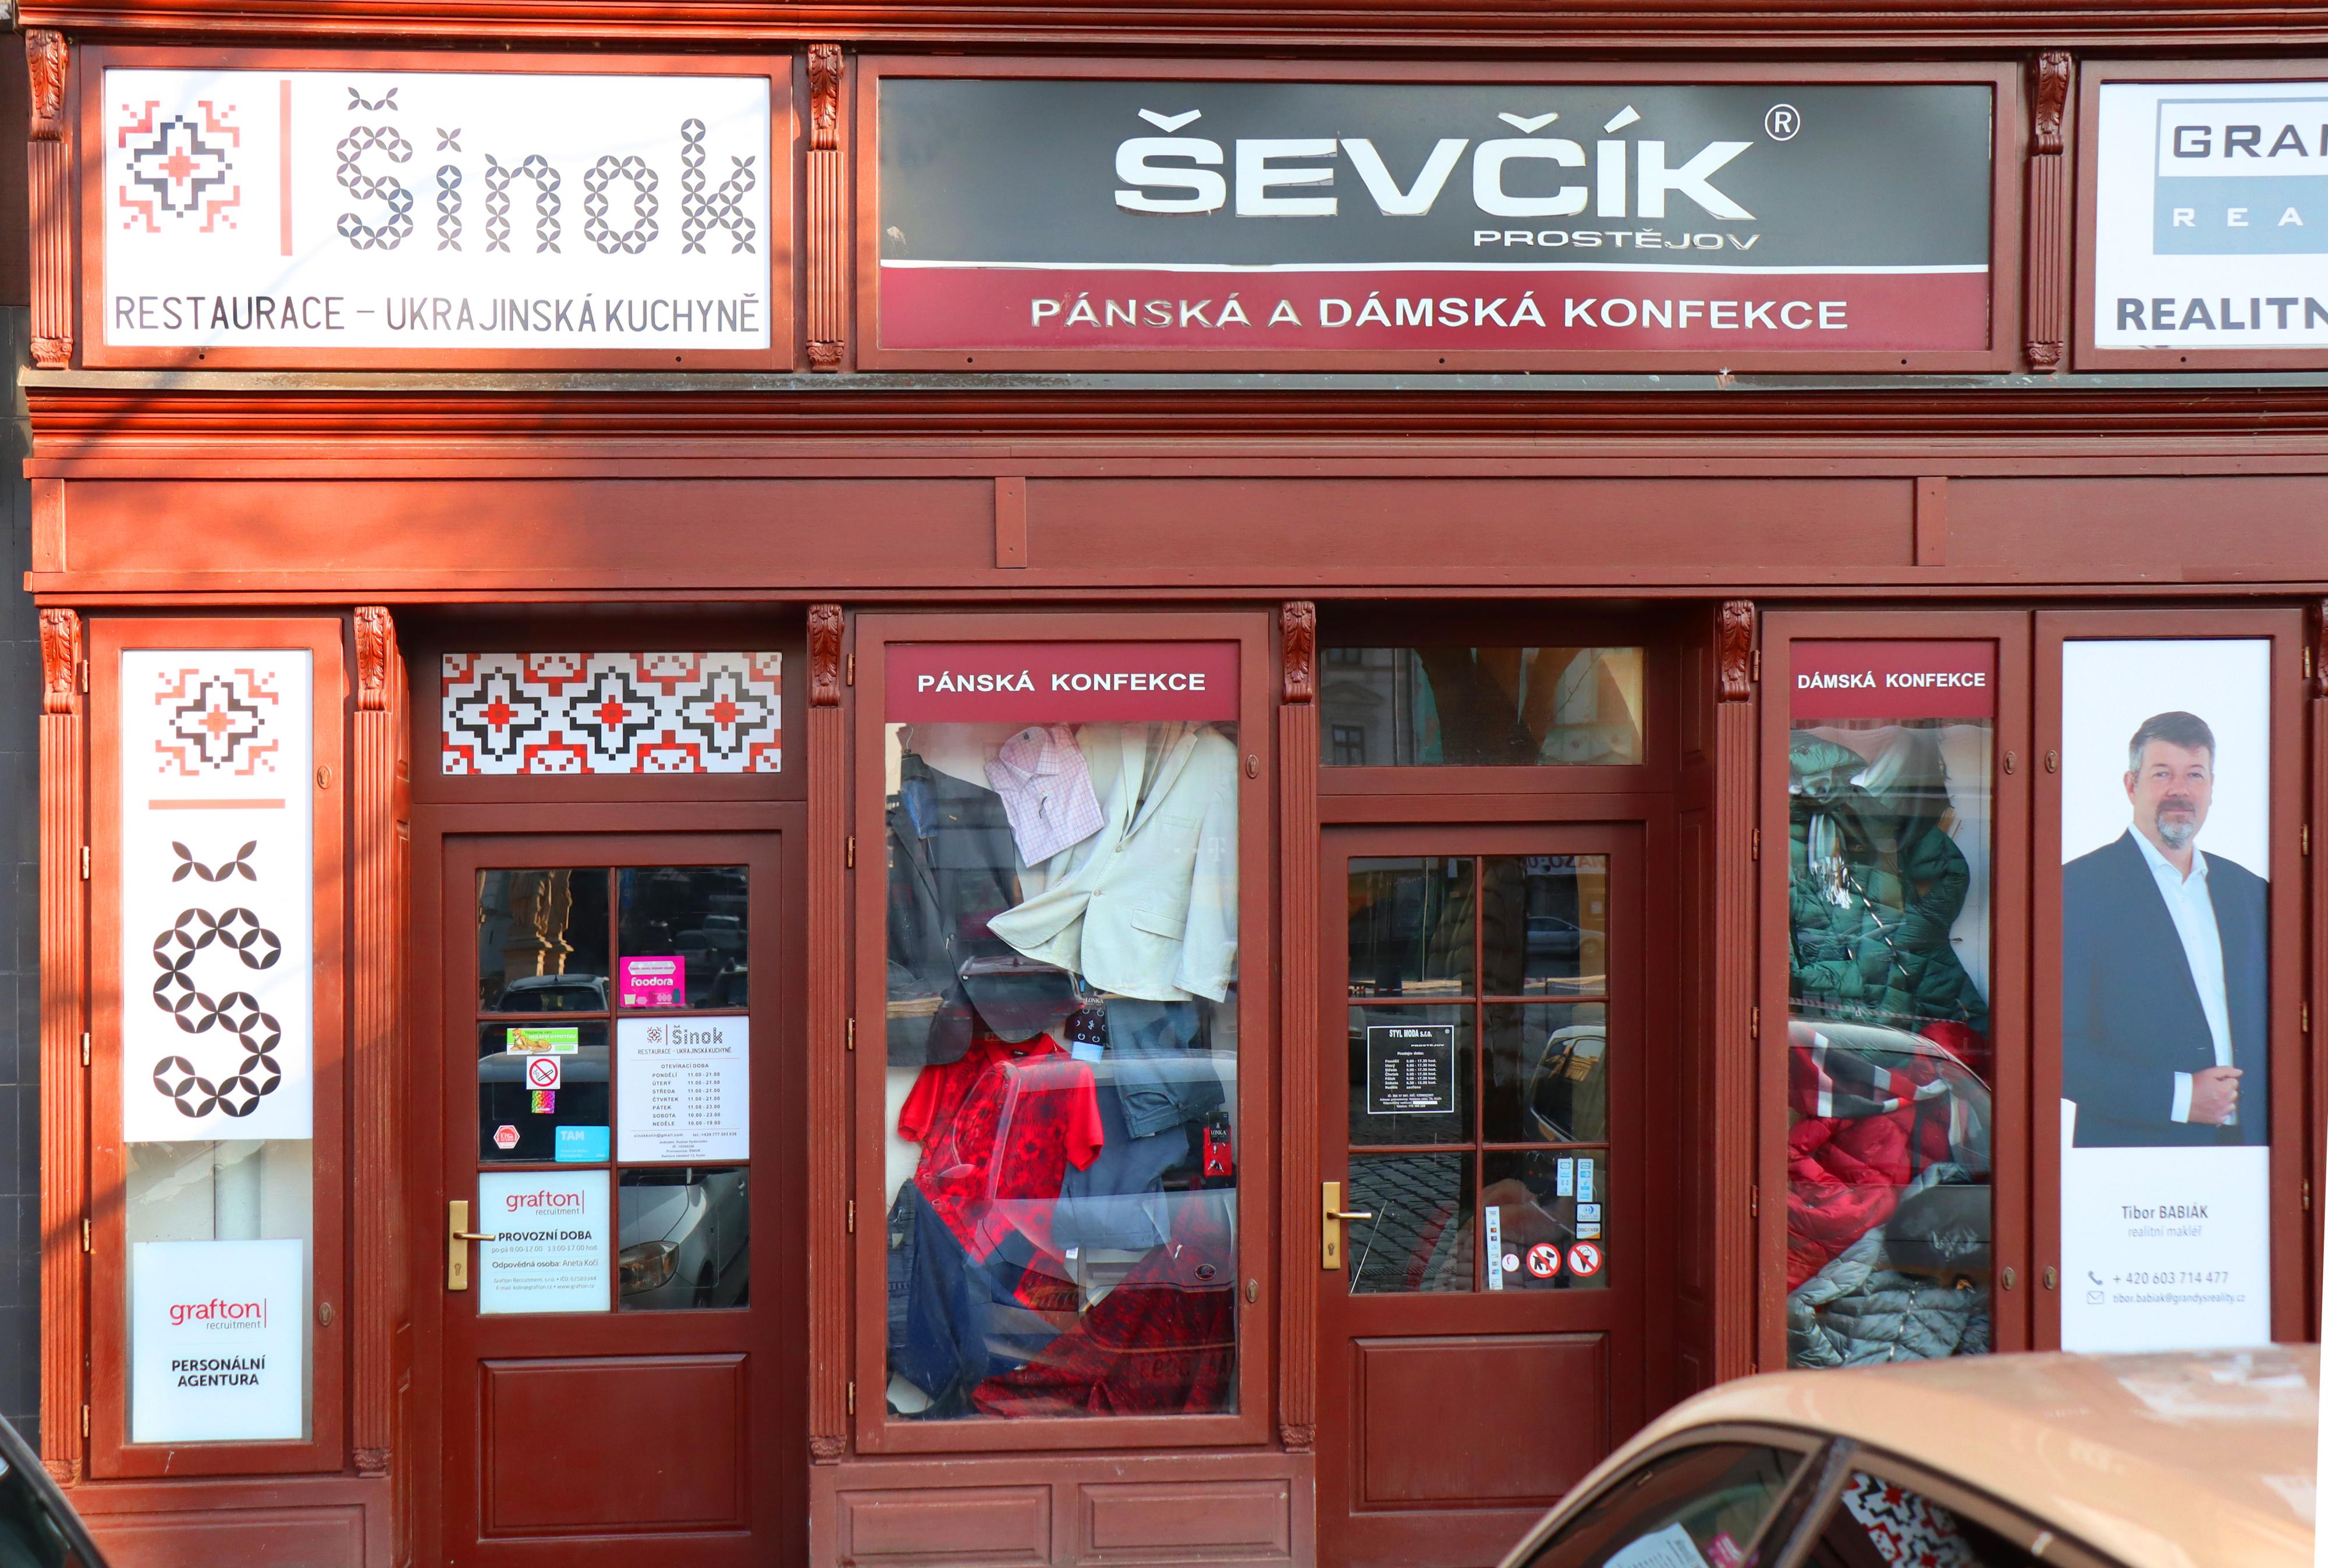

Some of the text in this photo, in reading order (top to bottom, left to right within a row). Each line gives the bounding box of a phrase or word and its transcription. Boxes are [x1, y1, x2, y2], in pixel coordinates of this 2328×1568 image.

[2174, 125, 2328, 158] GRA
[337, 86, 755, 254] Šinok
[1115, 105, 1756, 221] ŠEVČÍK
[1474, 228, 1761, 250] PROSTĚJOV
[116, 296, 345, 330] RESTAURACE
[386, 293, 596, 332] UKRAJINSKÁ
[605, 292, 760, 332] KUCHYNĚ
[1030, 291, 1849, 330] PÁNSKÁ A DÁMSKÁ KONFEKCE
[2117, 297, 2328, 330] REALITN
[918, 670, 1206, 692] PÁNSKÁ KONFEKCE
[1798, 671, 1986, 688] DÁMSKÁ KONFEKCE
[631, 977, 673, 986] foodora
[672, 1024, 723, 1044] Šinok
[560, 1131, 584, 1141] TAM
[506, 1190, 580, 1212] grafton
[2122, 1202, 2208, 1219] Tibor BABIÁK
[499, 1229, 592, 1241] PROVOZNÍ DOBA
[2128, 1225, 2202, 1237] realitní makléř
[2125, 1272, 2149, 1284] 420
[2153, 1272, 2175, 1284] 603
[2180, 1271, 2201, 1283] 714
[2206, 1271, 2228, 1283] 477
[169, 1298, 261, 1326] grafton
[207, 1321, 261, 1329] recruitment
[172, 1354, 266, 1371] PERSONÁLNÍ
[178, 1373, 259, 1387] AGENTURA
